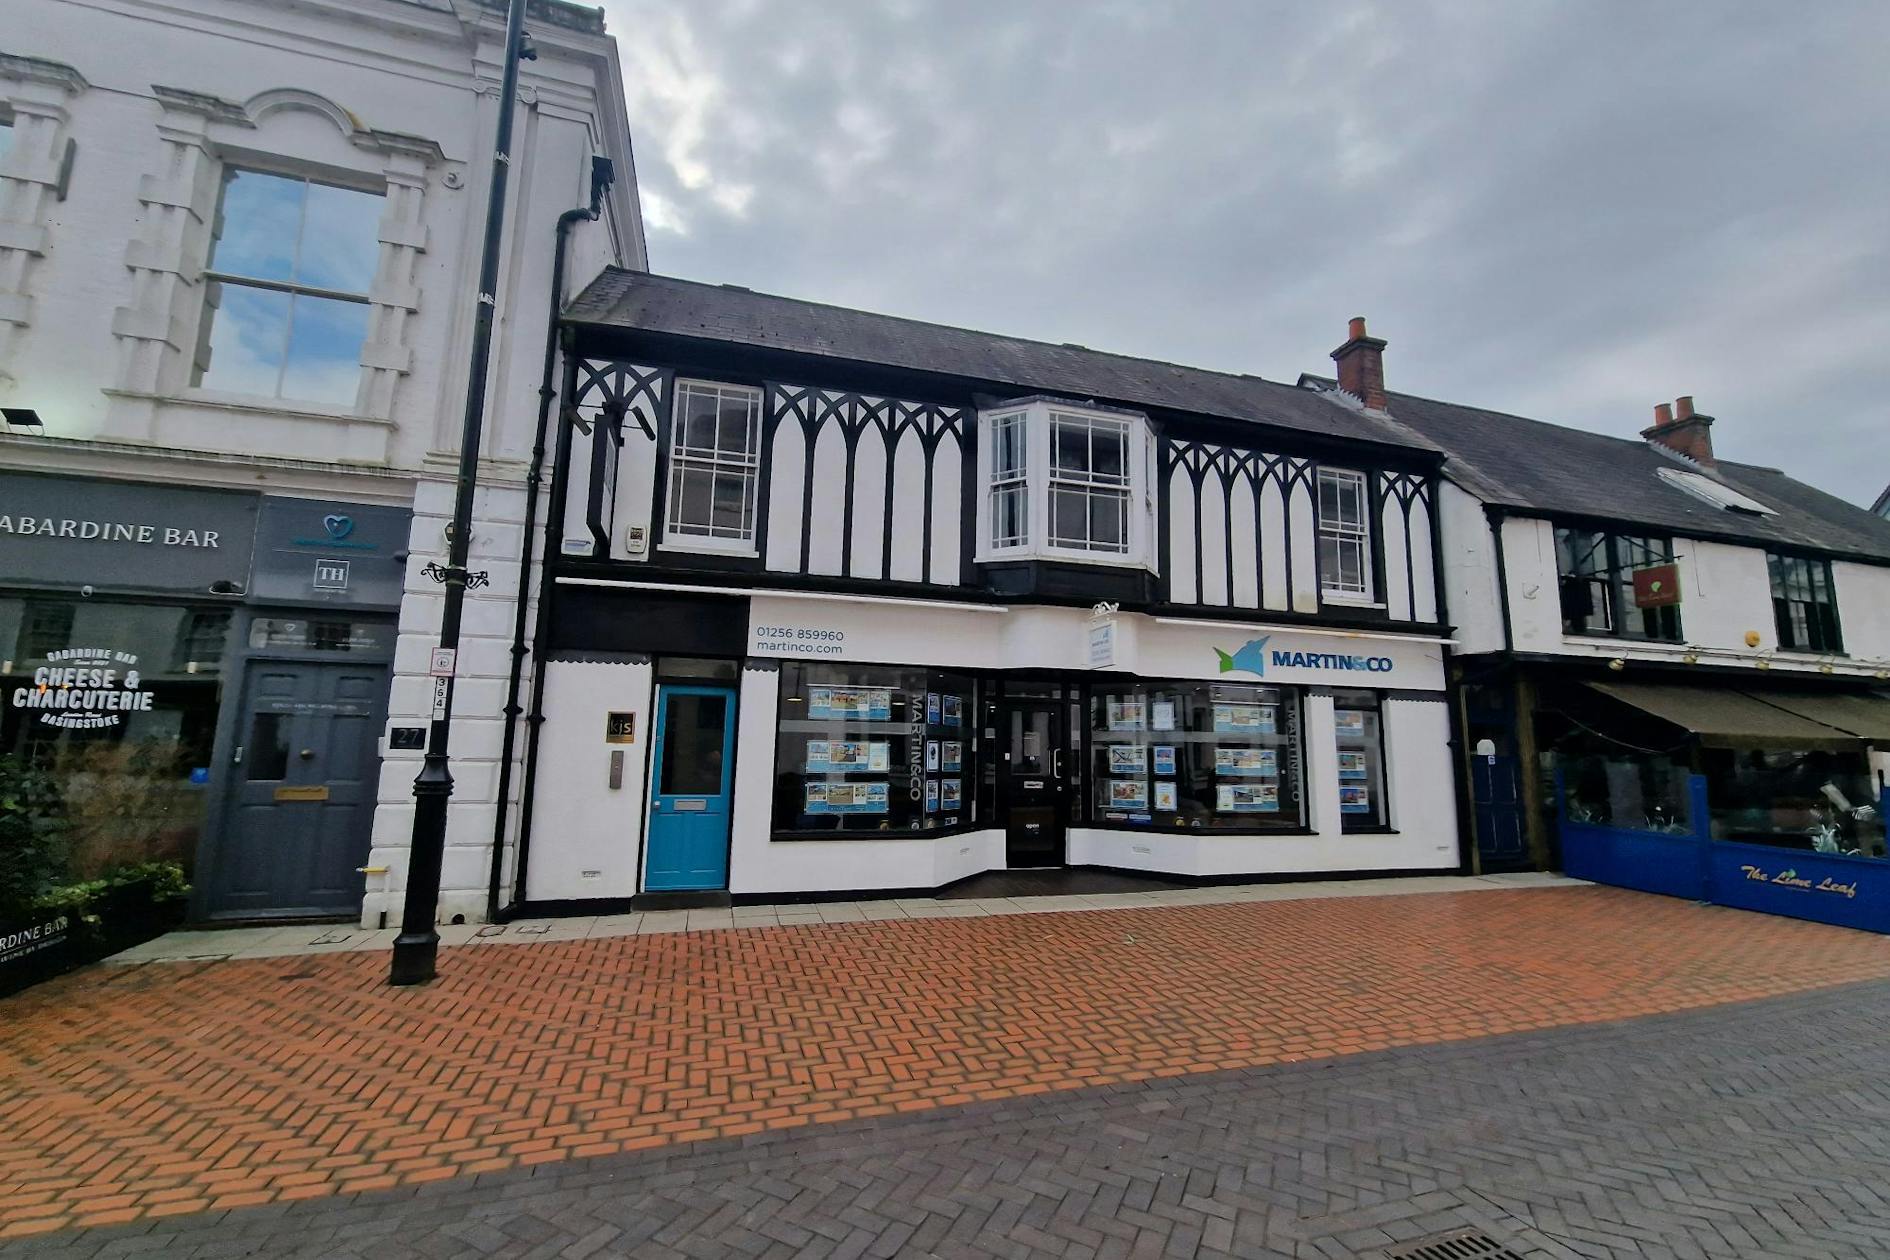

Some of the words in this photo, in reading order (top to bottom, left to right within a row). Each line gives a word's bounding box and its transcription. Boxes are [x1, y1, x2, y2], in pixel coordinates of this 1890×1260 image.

[0, 515, 155, 543] ABARDINE
[164, 527, 219, 548] BAR
[318, 566, 345, 581] TH
[757, 626, 793, 639] 01256
[797, 629, 844, 641] 859960
[757, 641, 843, 654] martinco.com
[1272, 650, 1393, 672] MARTIN&CO
[34, 666, 116, 689] CHEESE
[124, 670, 141, 690] &
[13, 687, 154, 711] CHARCUTERIE
[40, 713, 120, 729] BASINGSTOKE
[398, 728, 419, 745] 27
[910, 694, 923, 801] MARTIN&CO
[1741, 865, 1768, 881] The
[1815, 877, 1857, 898] Leaf
